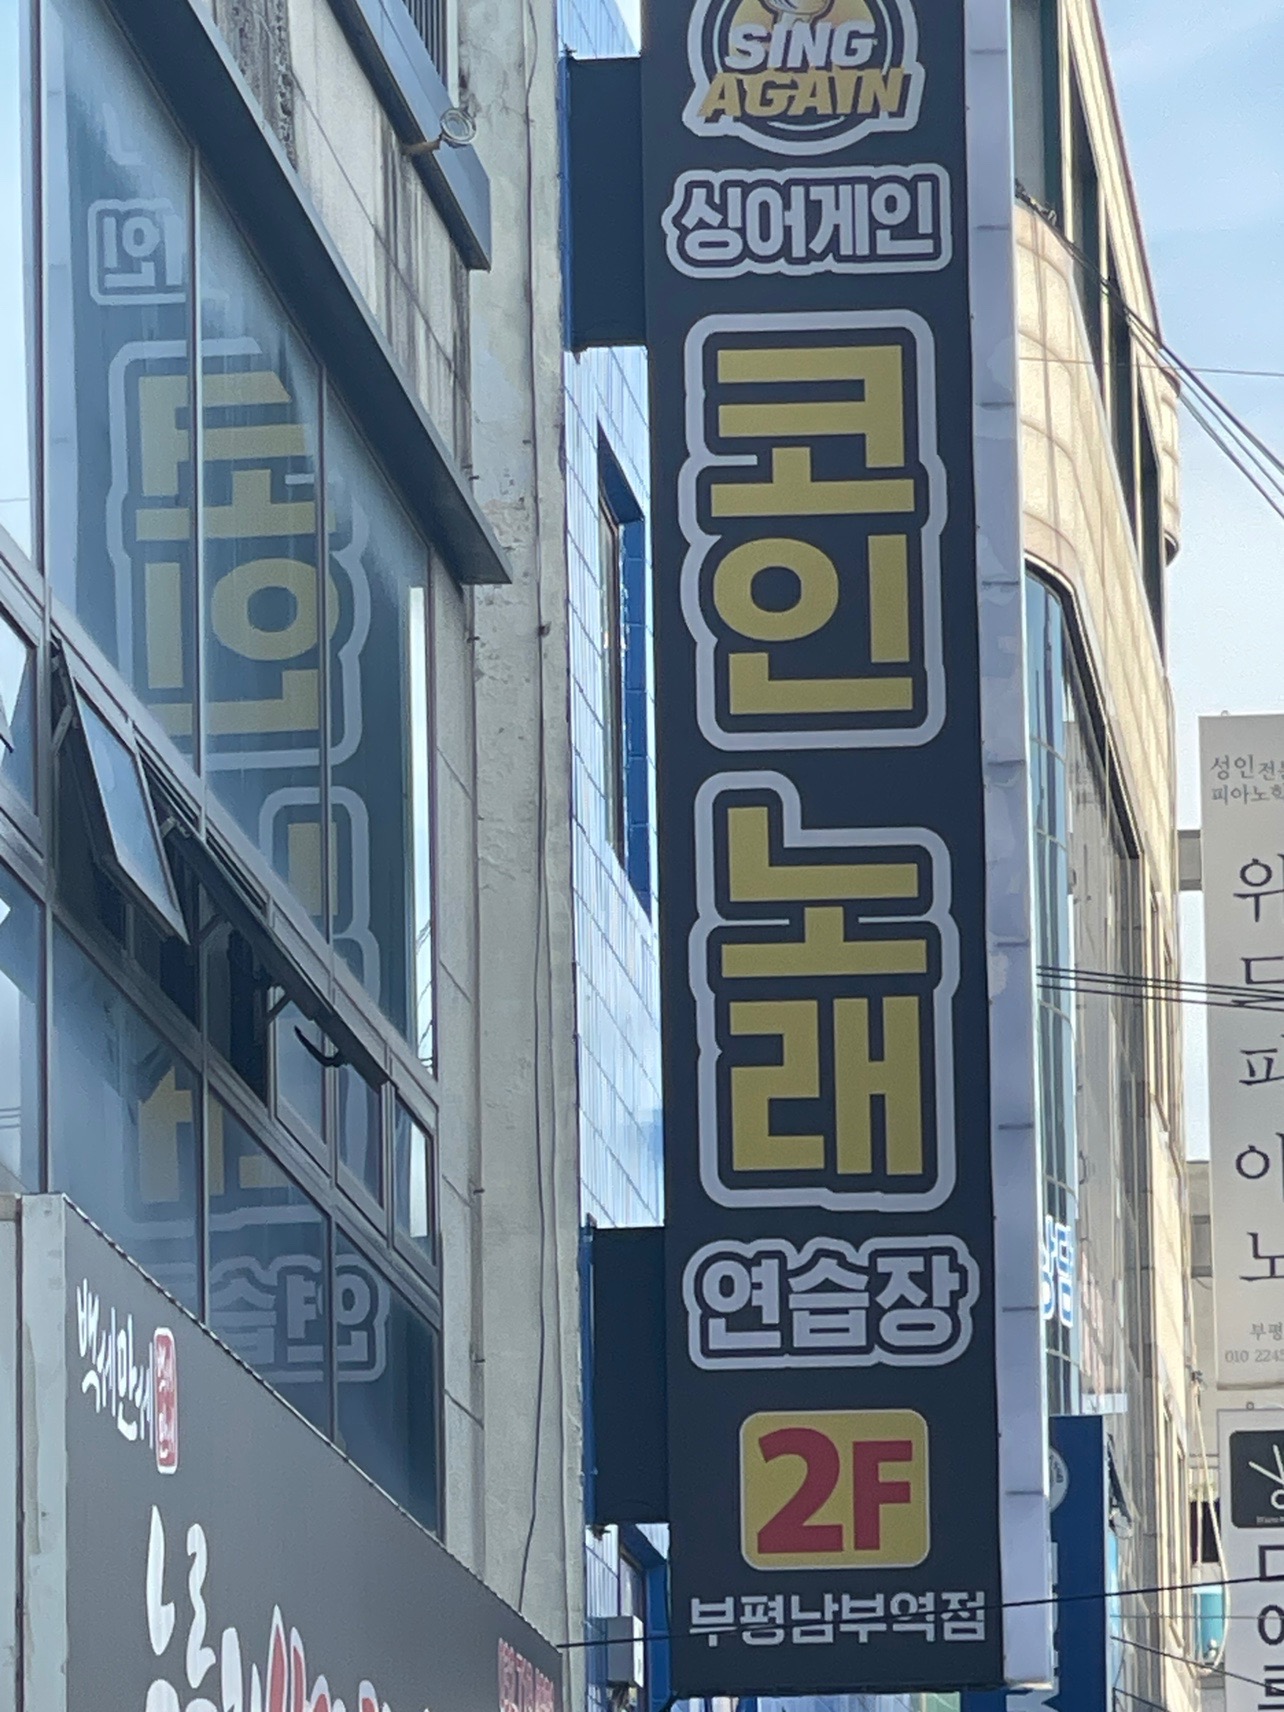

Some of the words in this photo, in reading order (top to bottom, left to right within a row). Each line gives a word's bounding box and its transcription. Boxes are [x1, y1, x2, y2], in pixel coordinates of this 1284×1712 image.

[725, 21, 878, 69] SING
[697, 67, 905, 118] AGAIN
[681, 180, 934, 260] 싱어게인
[711, 344, 915, 716] 코인
[1211, 754, 1254, 780] 성인
[722, 806, 927, 1176] 노래
[702, 1254, 961, 1351] 연습장
[1225, 1350, 1249, 1363] 010
[756, 1427, 913, 1554] 2F
[689, 1590, 986, 1648] 부평남부역점
